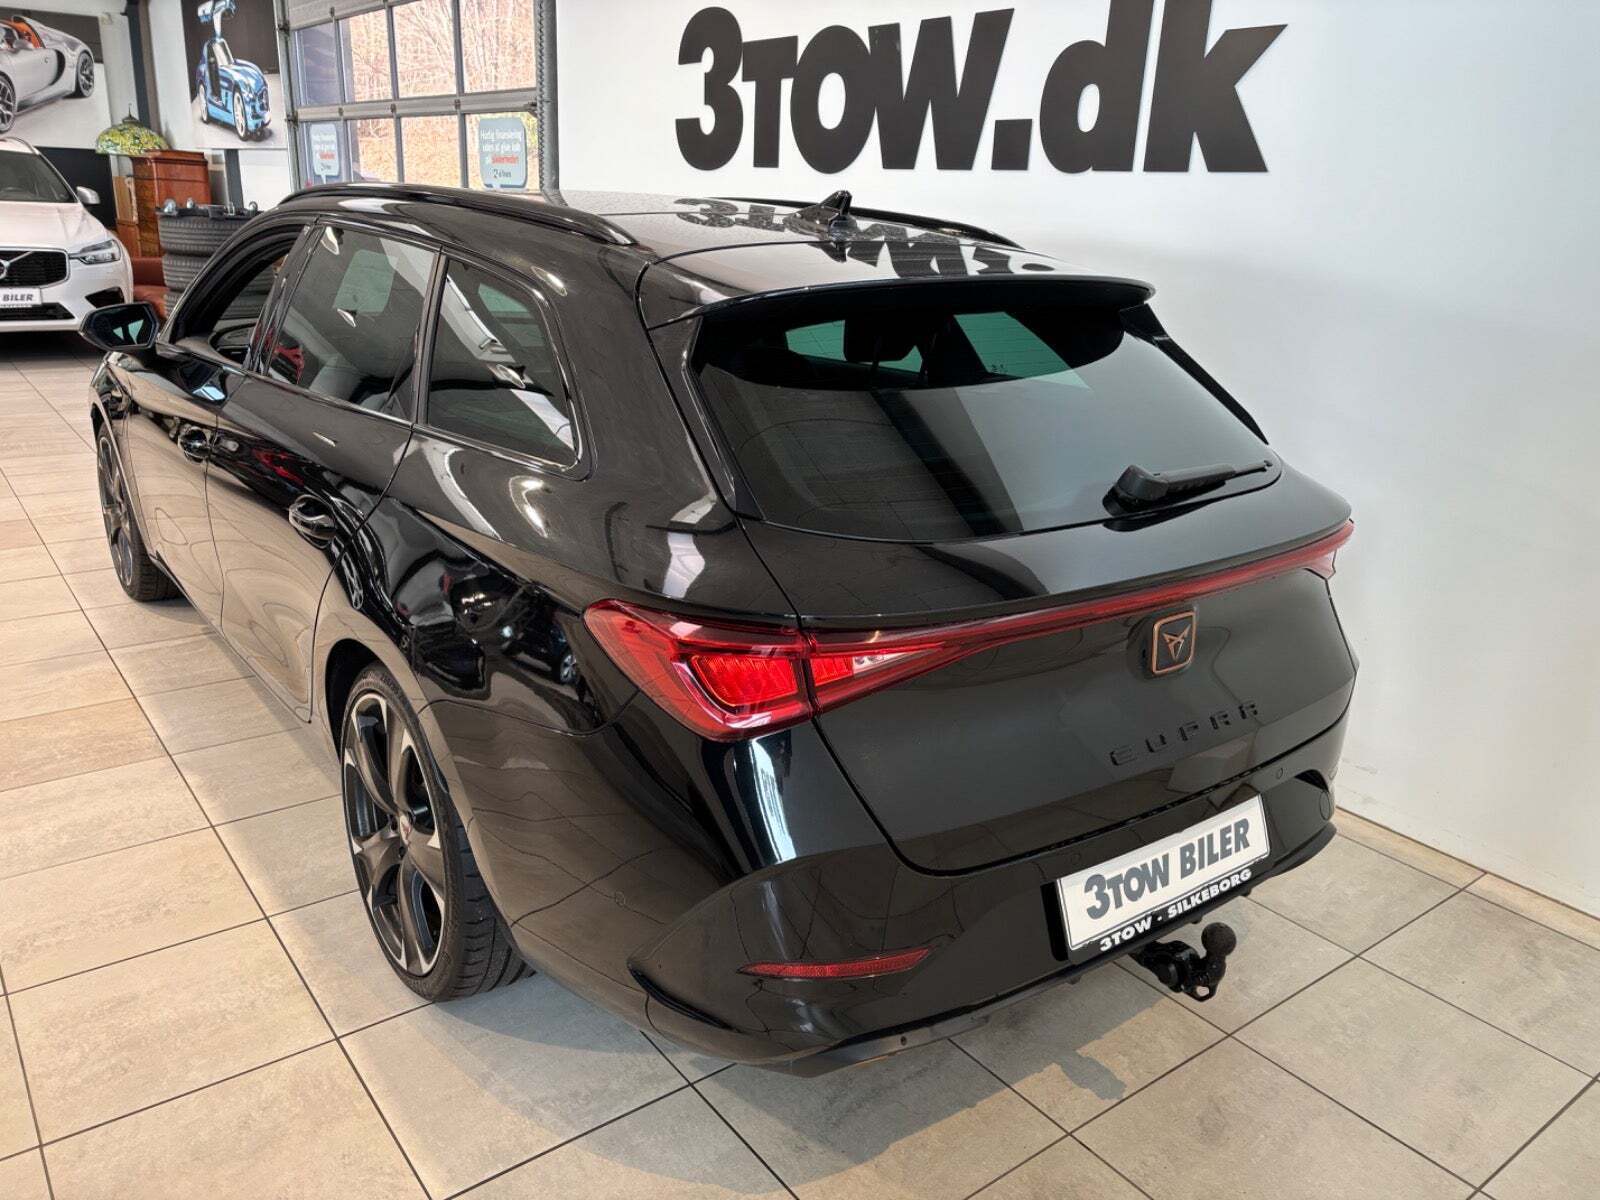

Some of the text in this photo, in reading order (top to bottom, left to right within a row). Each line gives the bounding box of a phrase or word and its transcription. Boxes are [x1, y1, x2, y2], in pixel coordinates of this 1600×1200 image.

[675, 0, 1288, 175] 3TOW.dk
[3, 293, 34, 301] BILER
[1084, 818, 1250, 920] 3TOW BILER
[1100, 916, 1154, 951] 3TOW
[1167, 868, 1253, 919] SILKEBORG
